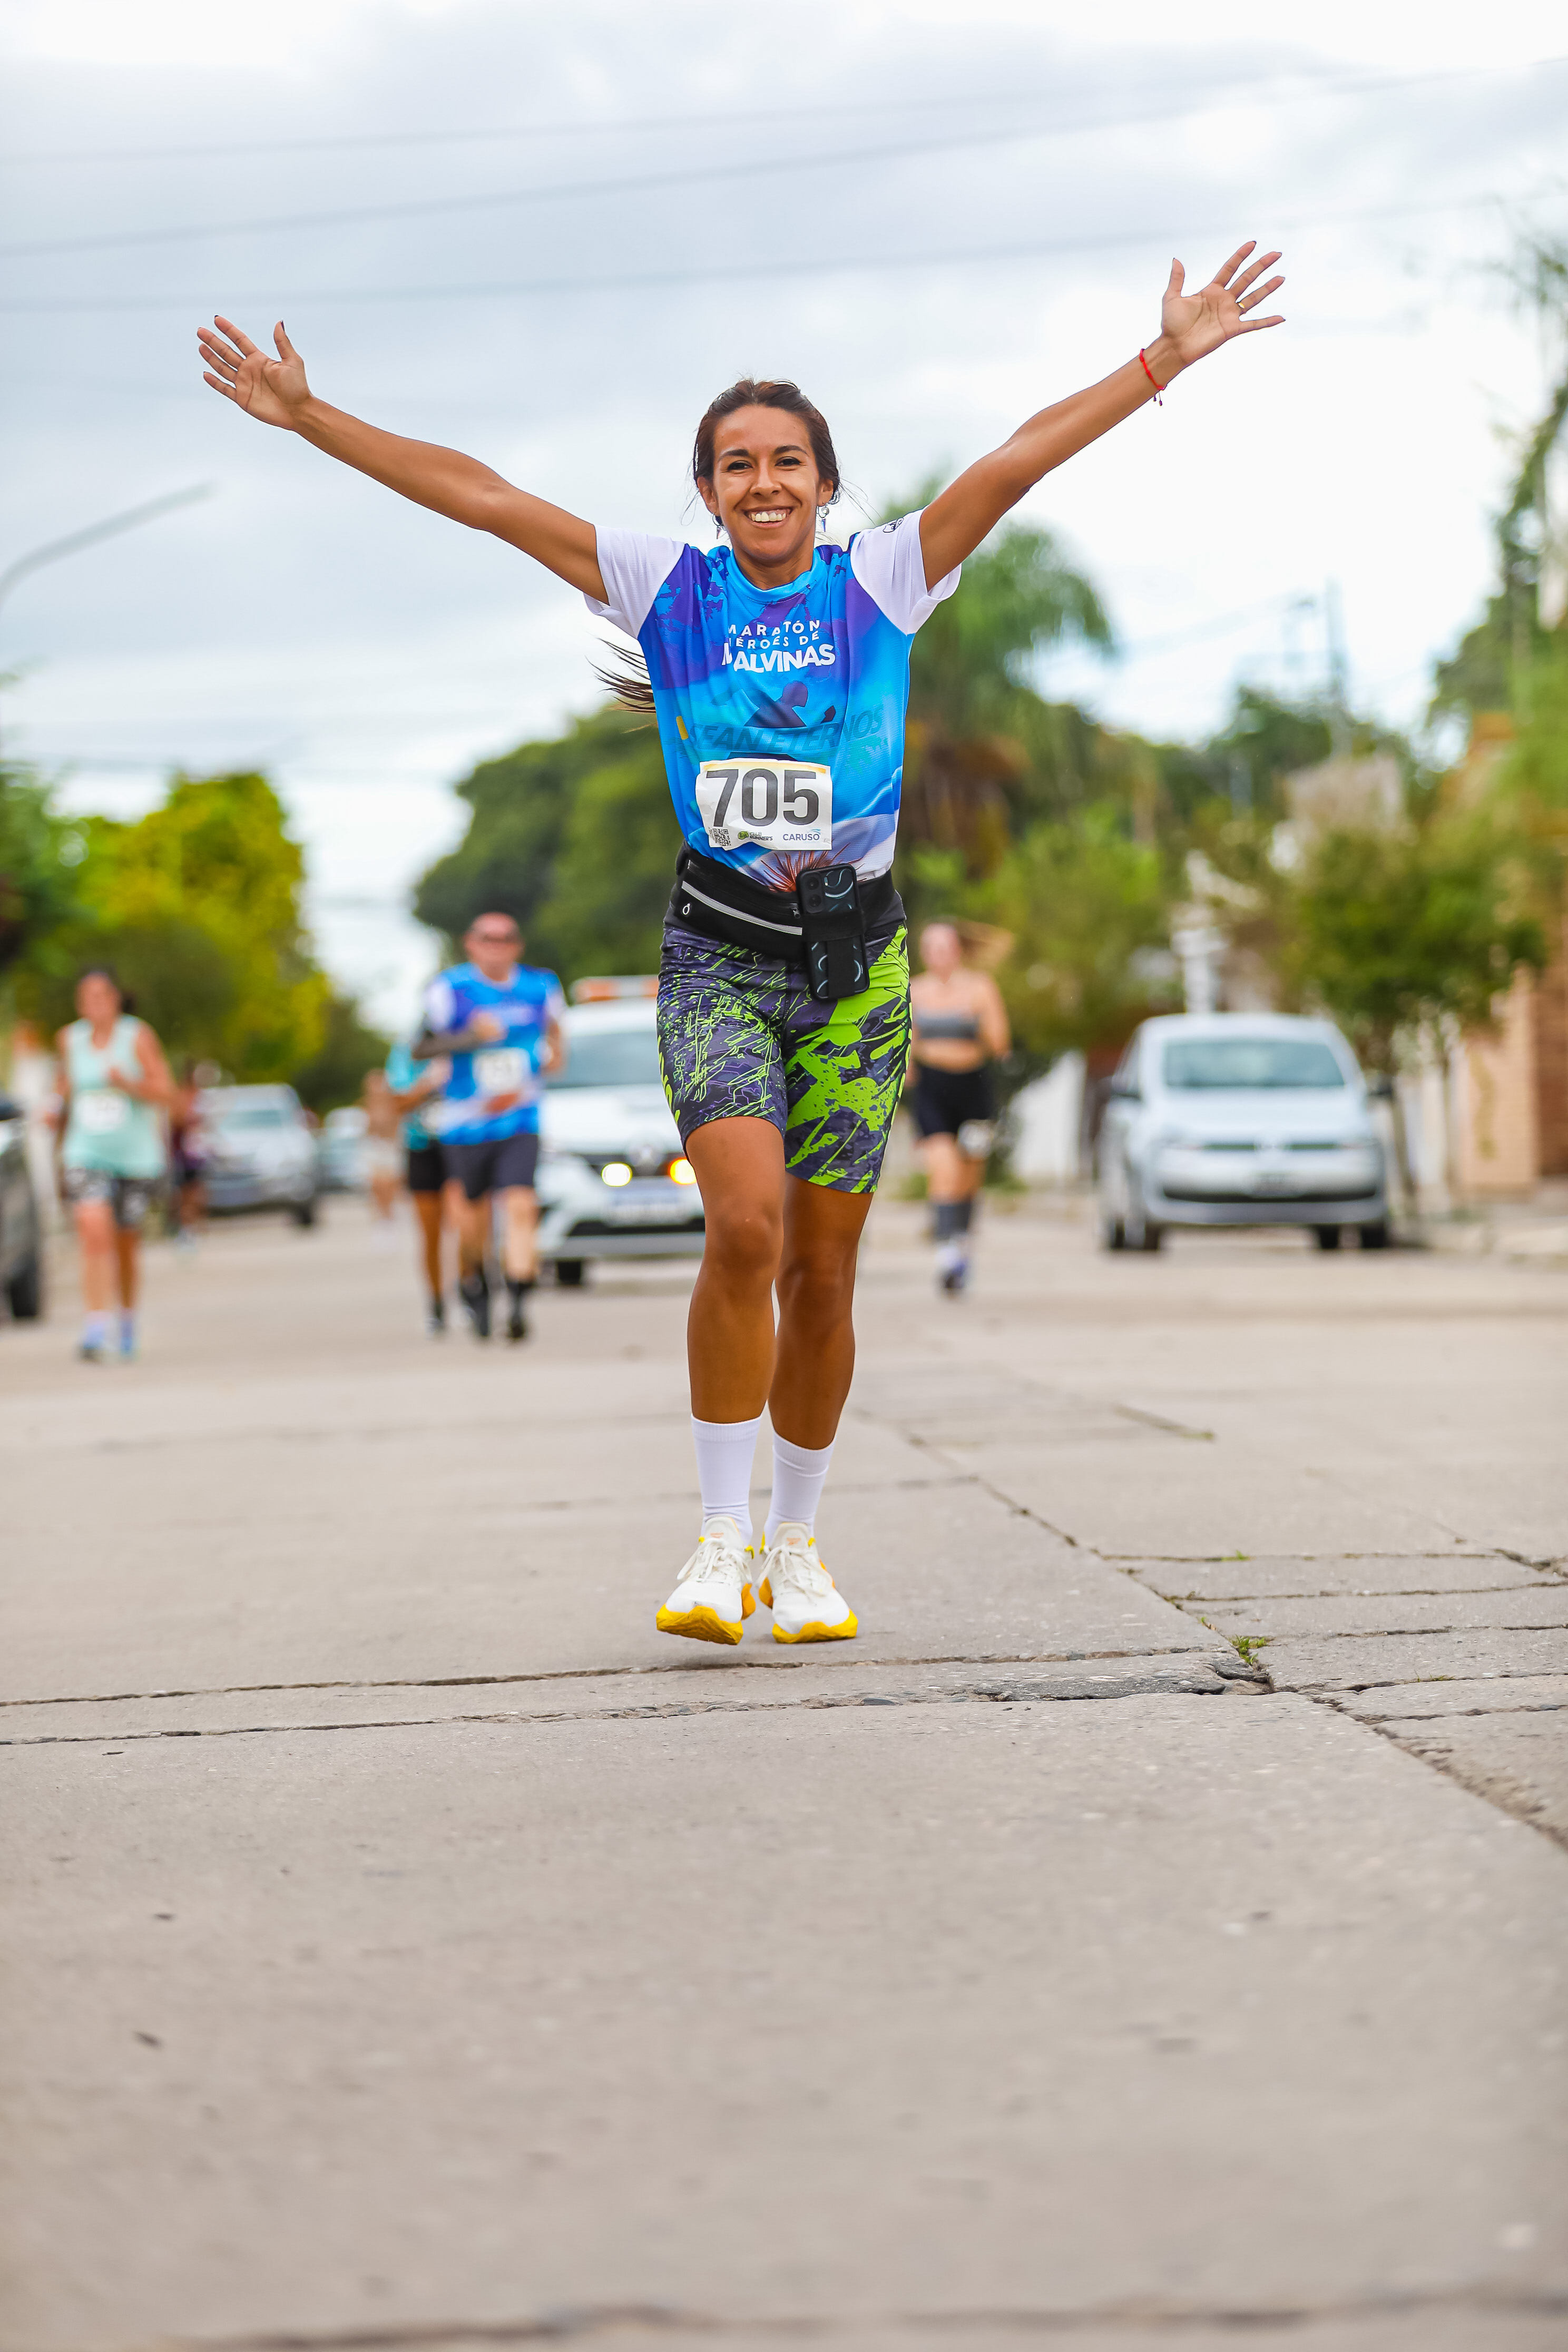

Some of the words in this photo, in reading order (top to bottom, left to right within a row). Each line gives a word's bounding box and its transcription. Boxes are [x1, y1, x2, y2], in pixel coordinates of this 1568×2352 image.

[728, 620, 820, 636] MARATÓN
[799, 631, 819, 645] DE
[769, 705, 883, 752] ETERNOS
[706, 769, 819, 827] 705
